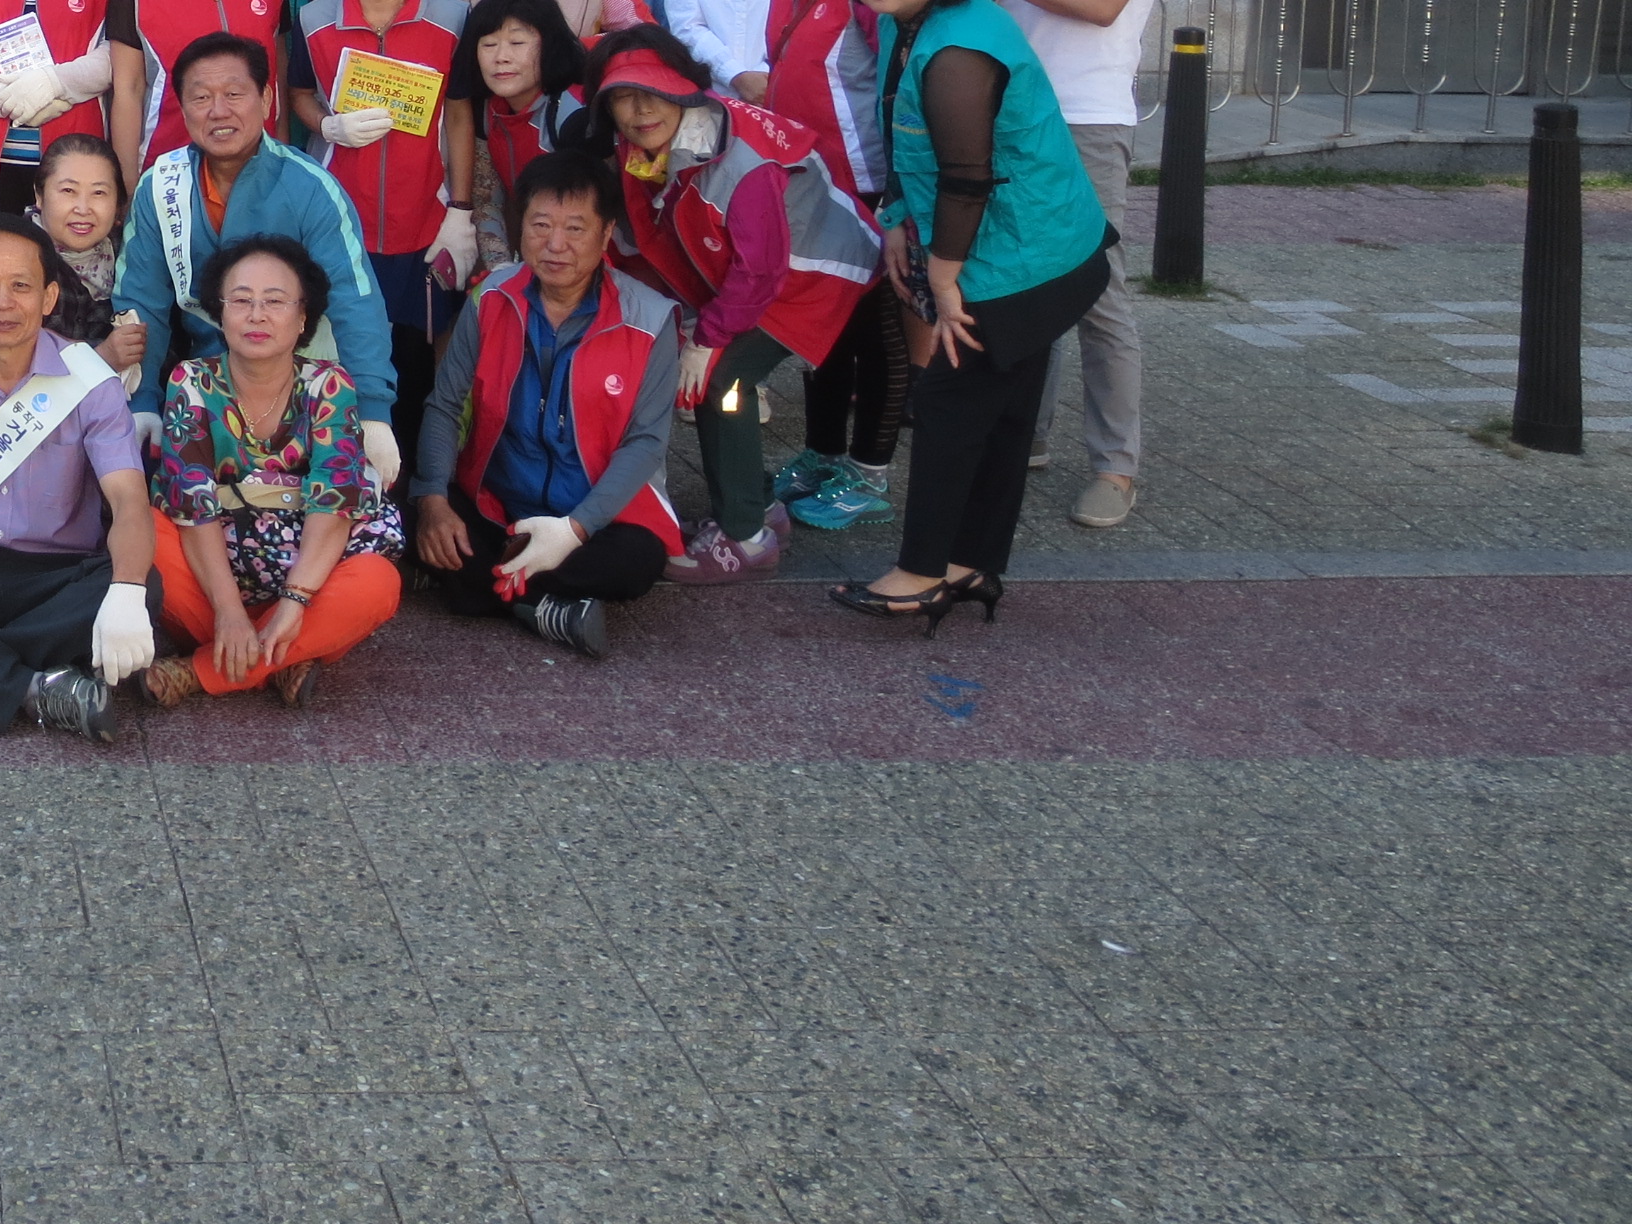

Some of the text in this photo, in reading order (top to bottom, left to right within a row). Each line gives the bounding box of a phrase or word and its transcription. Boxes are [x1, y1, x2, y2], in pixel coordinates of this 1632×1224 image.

[348, 77, 365, 90] 추석
[366, 81, 382, 94] 연휴
[346, 88, 367, 104] 쓰레기
[159, 162, 191, 175] 동작구
[163, 173, 183, 239] 거울처럼
[12, 400, 44, 433] 동작구
